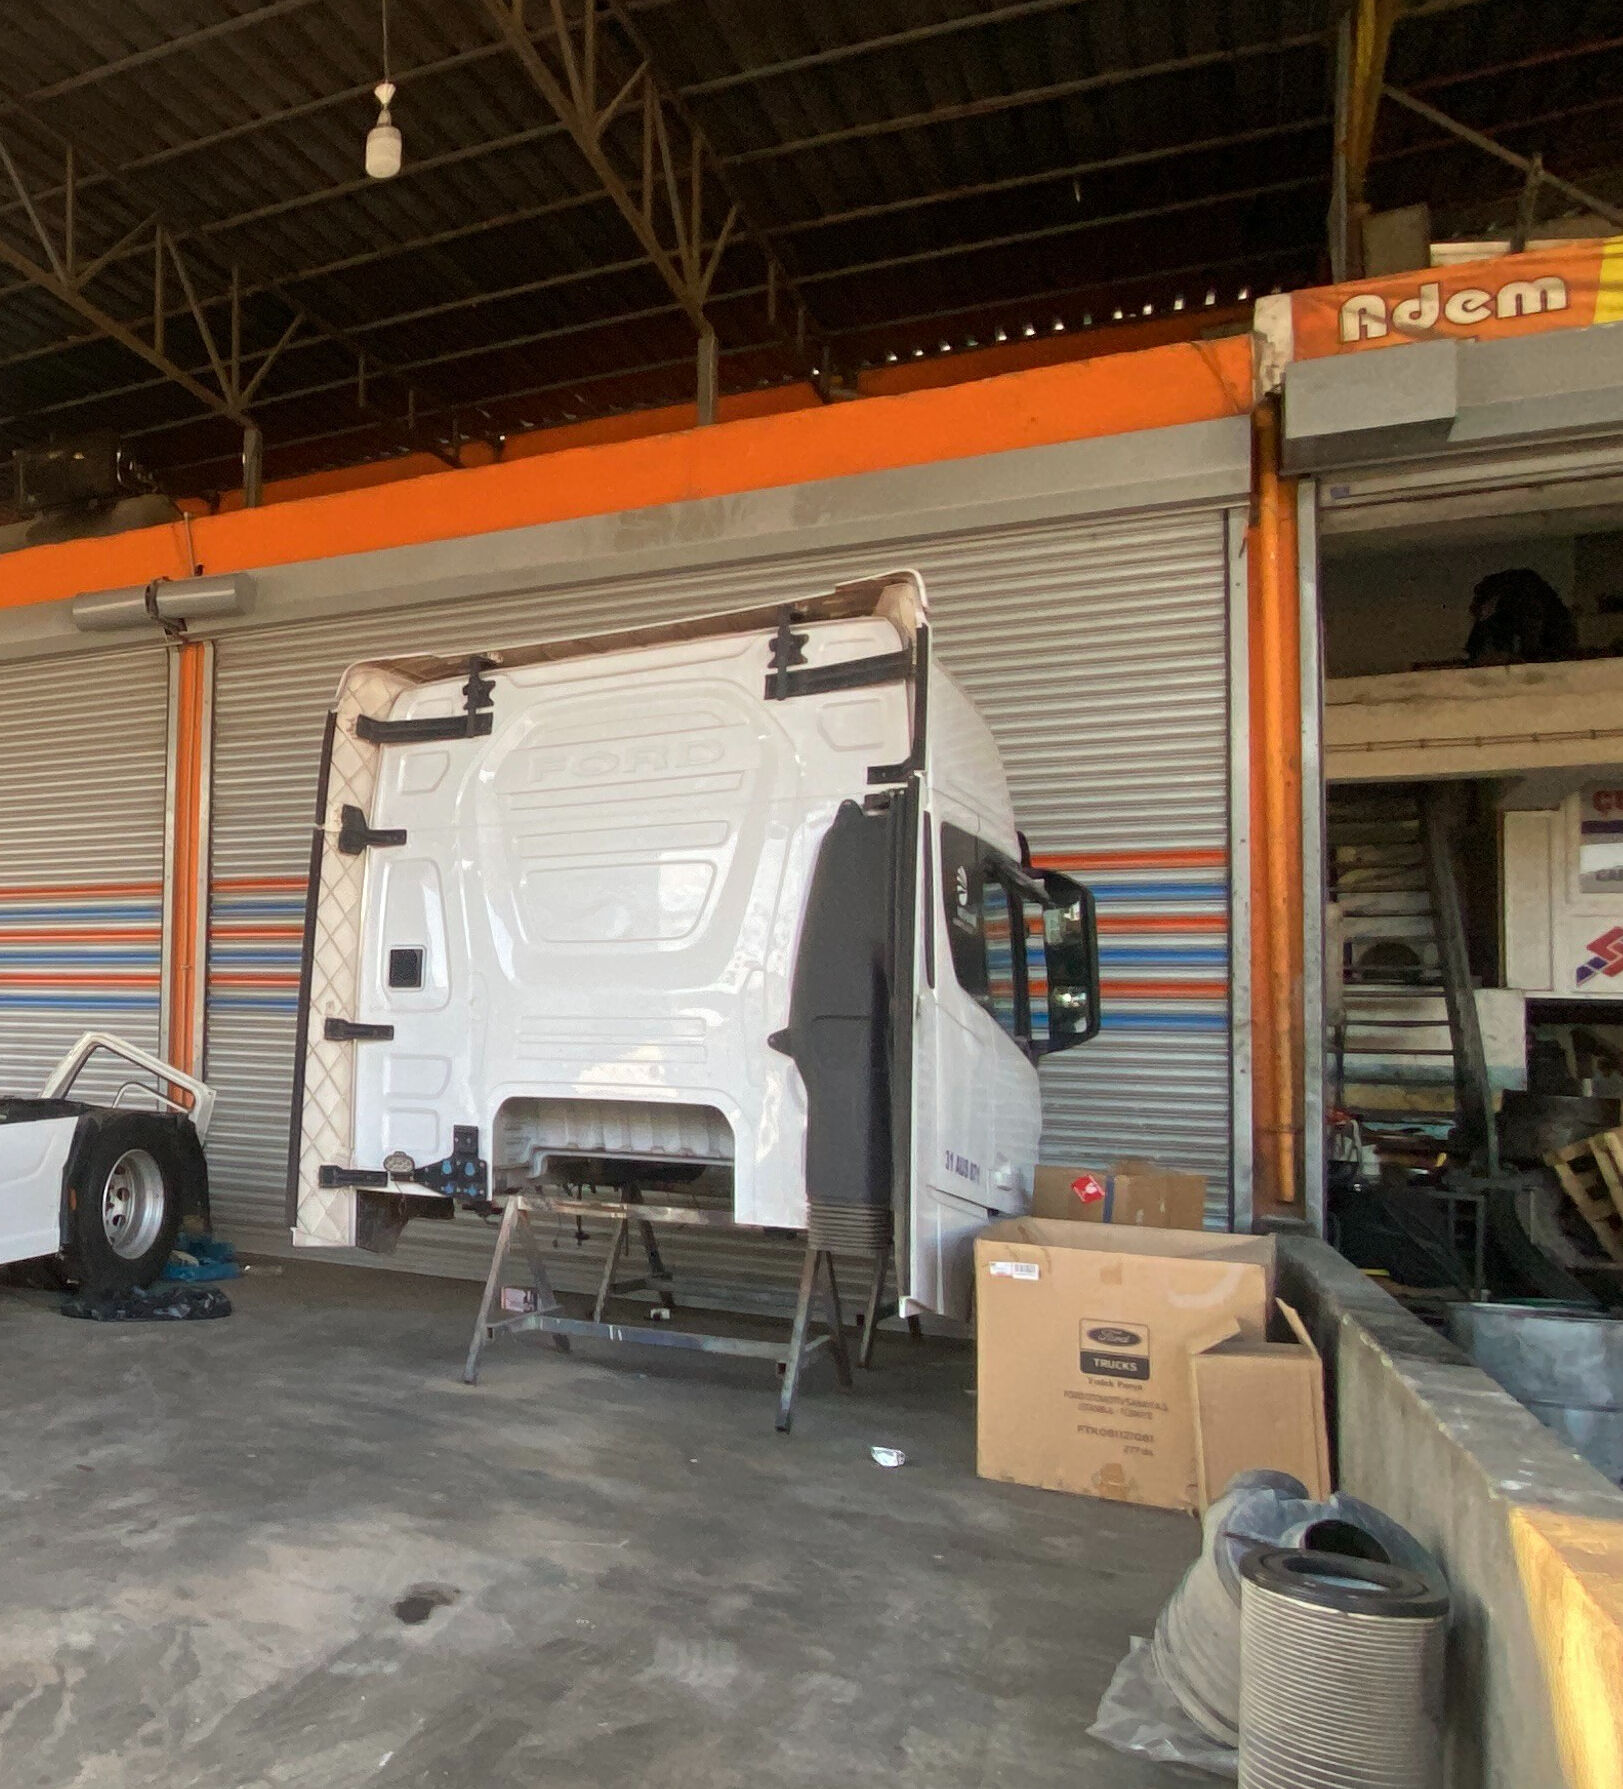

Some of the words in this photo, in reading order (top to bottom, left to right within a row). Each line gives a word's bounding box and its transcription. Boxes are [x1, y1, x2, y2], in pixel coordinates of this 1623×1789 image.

[1339, 275, 1569, 344] Adem
[527, 740, 727, 785] FORD
[1093, 1357, 1139, 1373] TRUCKS
